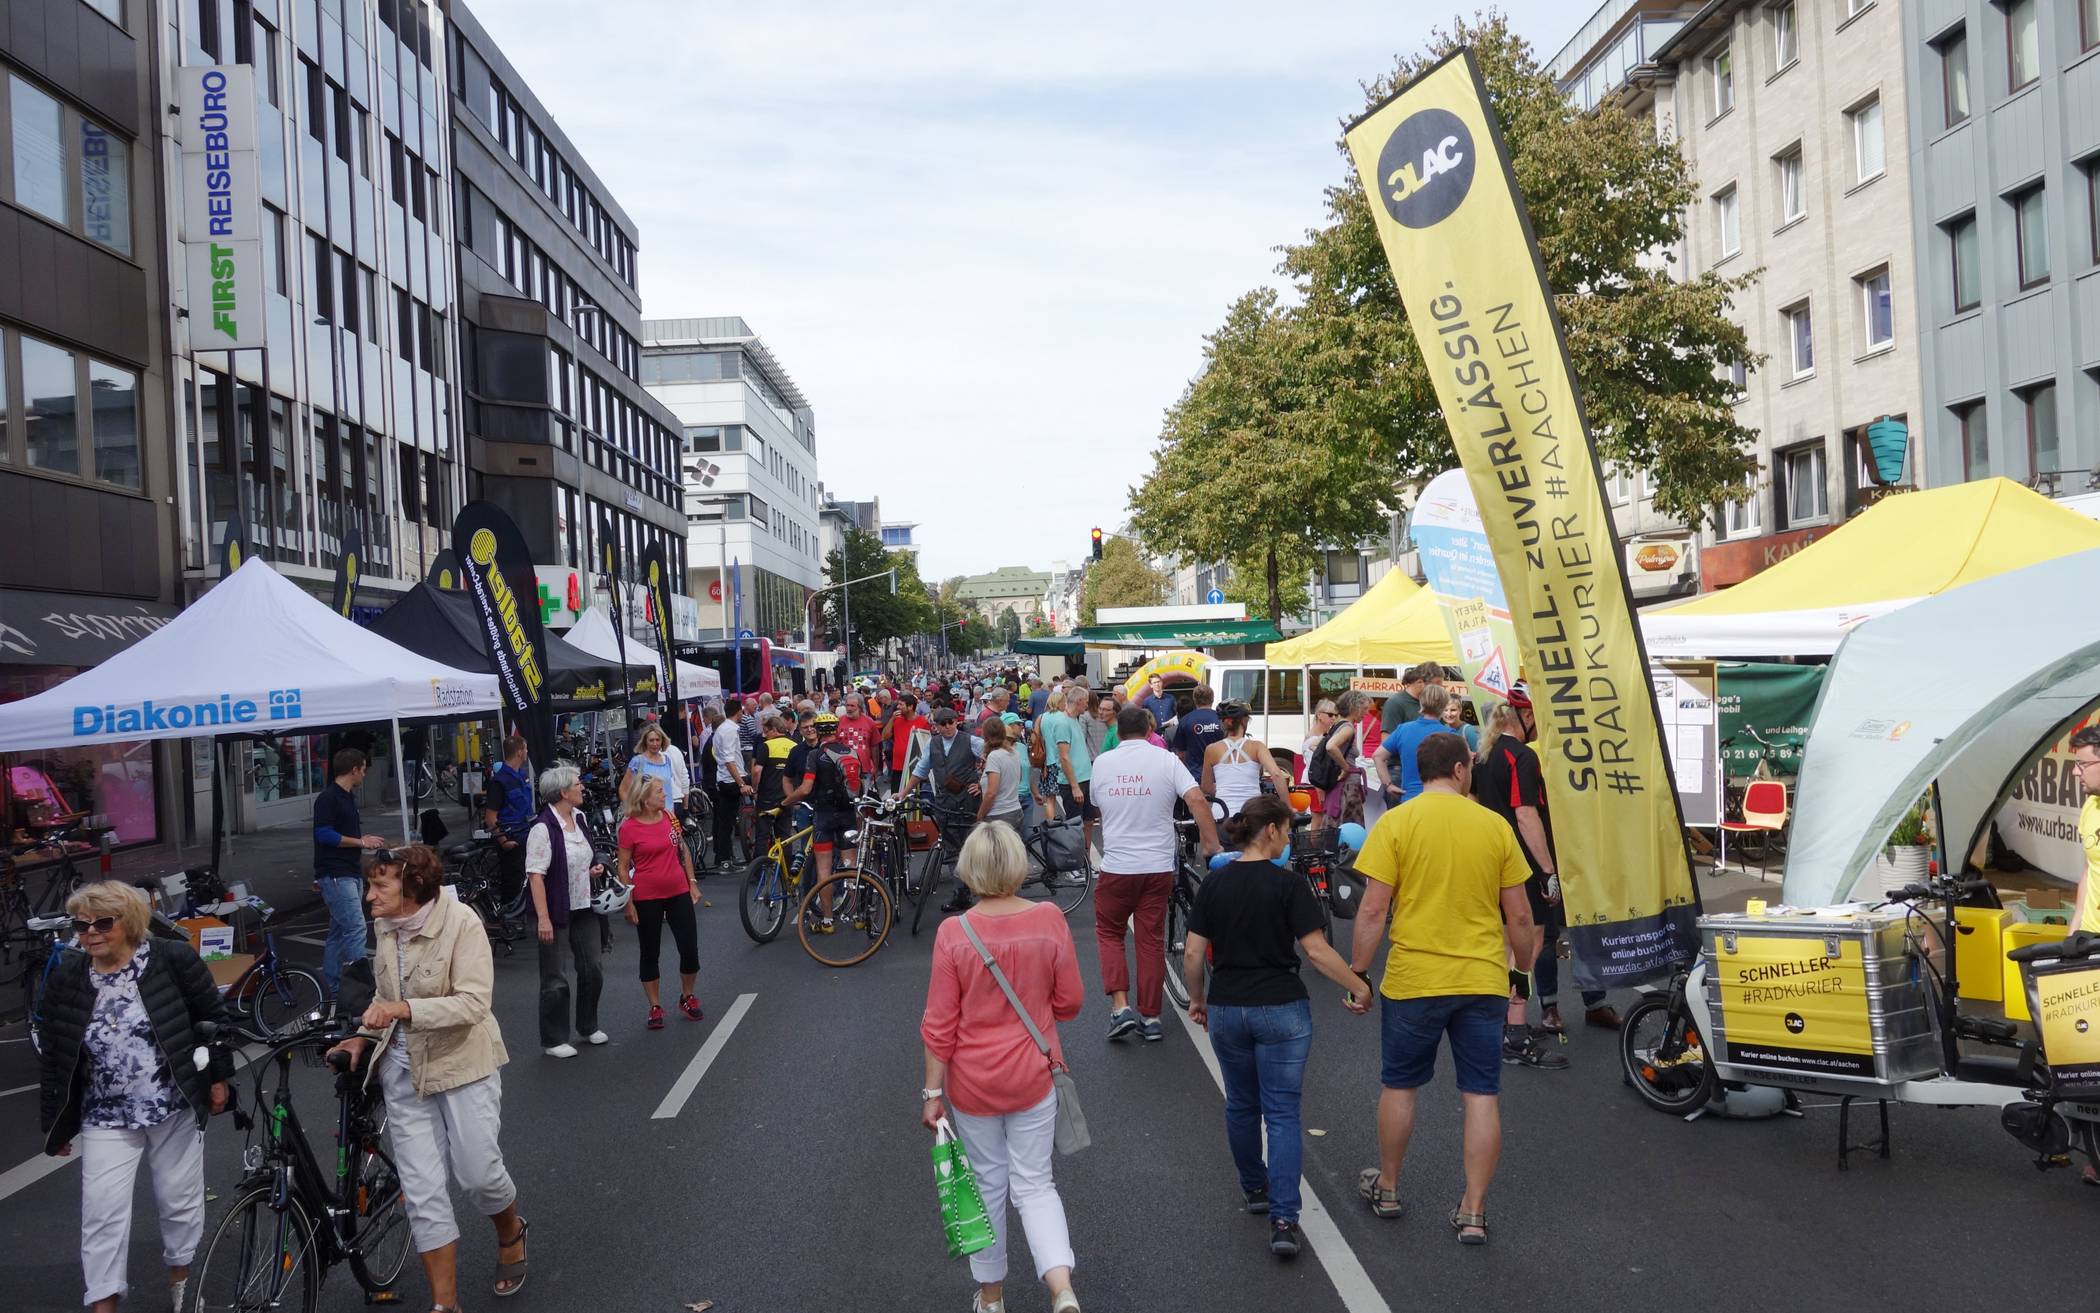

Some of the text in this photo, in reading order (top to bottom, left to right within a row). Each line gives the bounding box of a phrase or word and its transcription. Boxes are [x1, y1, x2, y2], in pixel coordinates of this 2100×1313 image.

[200, 71, 237, 342] FIRST REISEBÜRO
[1430, 281, 1544, 571] ZUVERLÄSSIG.
[1485, 302, 1644, 794] #RADKURIER #AACHEN
[1533, 583, 1598, 792] SCHNELL.
[73, 693, 257, 736] Diakonie
[1765, 726, 1780, 734] und
[1734, 750, 1744, 759] 21
[1749, 750, 1759, 758] 61
[1780, 750, 1792, 758] 89
[1108, 787, 1152, 796] CATELLA
[1116, 775, 1143, 783] TEAM
[1601, 922, 1676, 947] Kuriertransporte
[1611, 938, 1674, 959] online buchen:
[1739, 956, 1836, 984] SCHNELLER.
[1743, 977, 1843, 1004] #RADKURIER
[1740, 1051, 1759, 1059] Kurier
[1778, 1055, 1800, 1063] buchen:
[1801, 1058, 1860, 1069] www.clac.at/aachen
